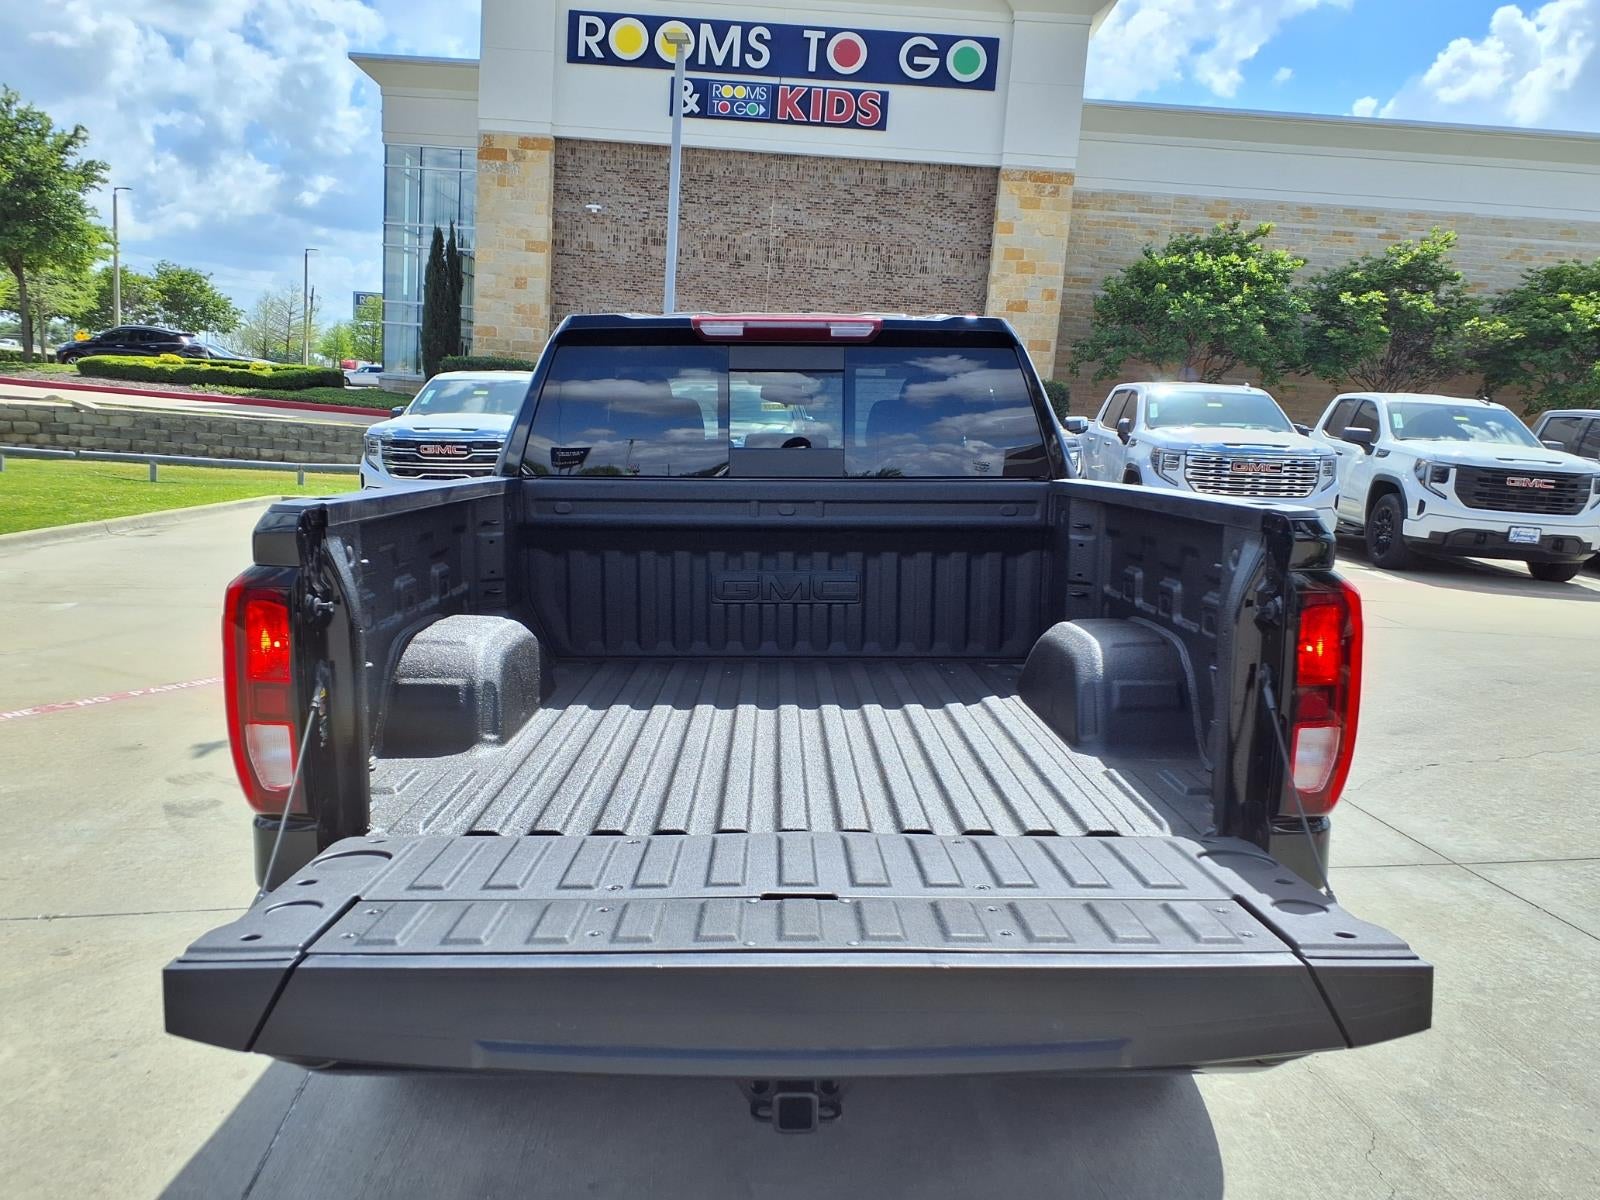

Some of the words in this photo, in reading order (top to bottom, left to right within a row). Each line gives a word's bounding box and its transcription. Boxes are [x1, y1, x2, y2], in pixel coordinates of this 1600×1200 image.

[577, 15, 772, 69] ROOMS
[803, 29, 868, 75] TO
[898, 35, 988, 83] GO
[681, 80, 701, 114] &
[712, 83, 767, 101] ROOMS
[712, 99, 731, 114] TO
[733, 101, 760, 116] GO
[777, 85, 882, 127] KIDS
[420, 444, 468, 455] GMC
[1232, 462, 1282, 473] GMC
[1506, 476, 1556, 489] GMC
[713, 572, 858, 601] GMC
